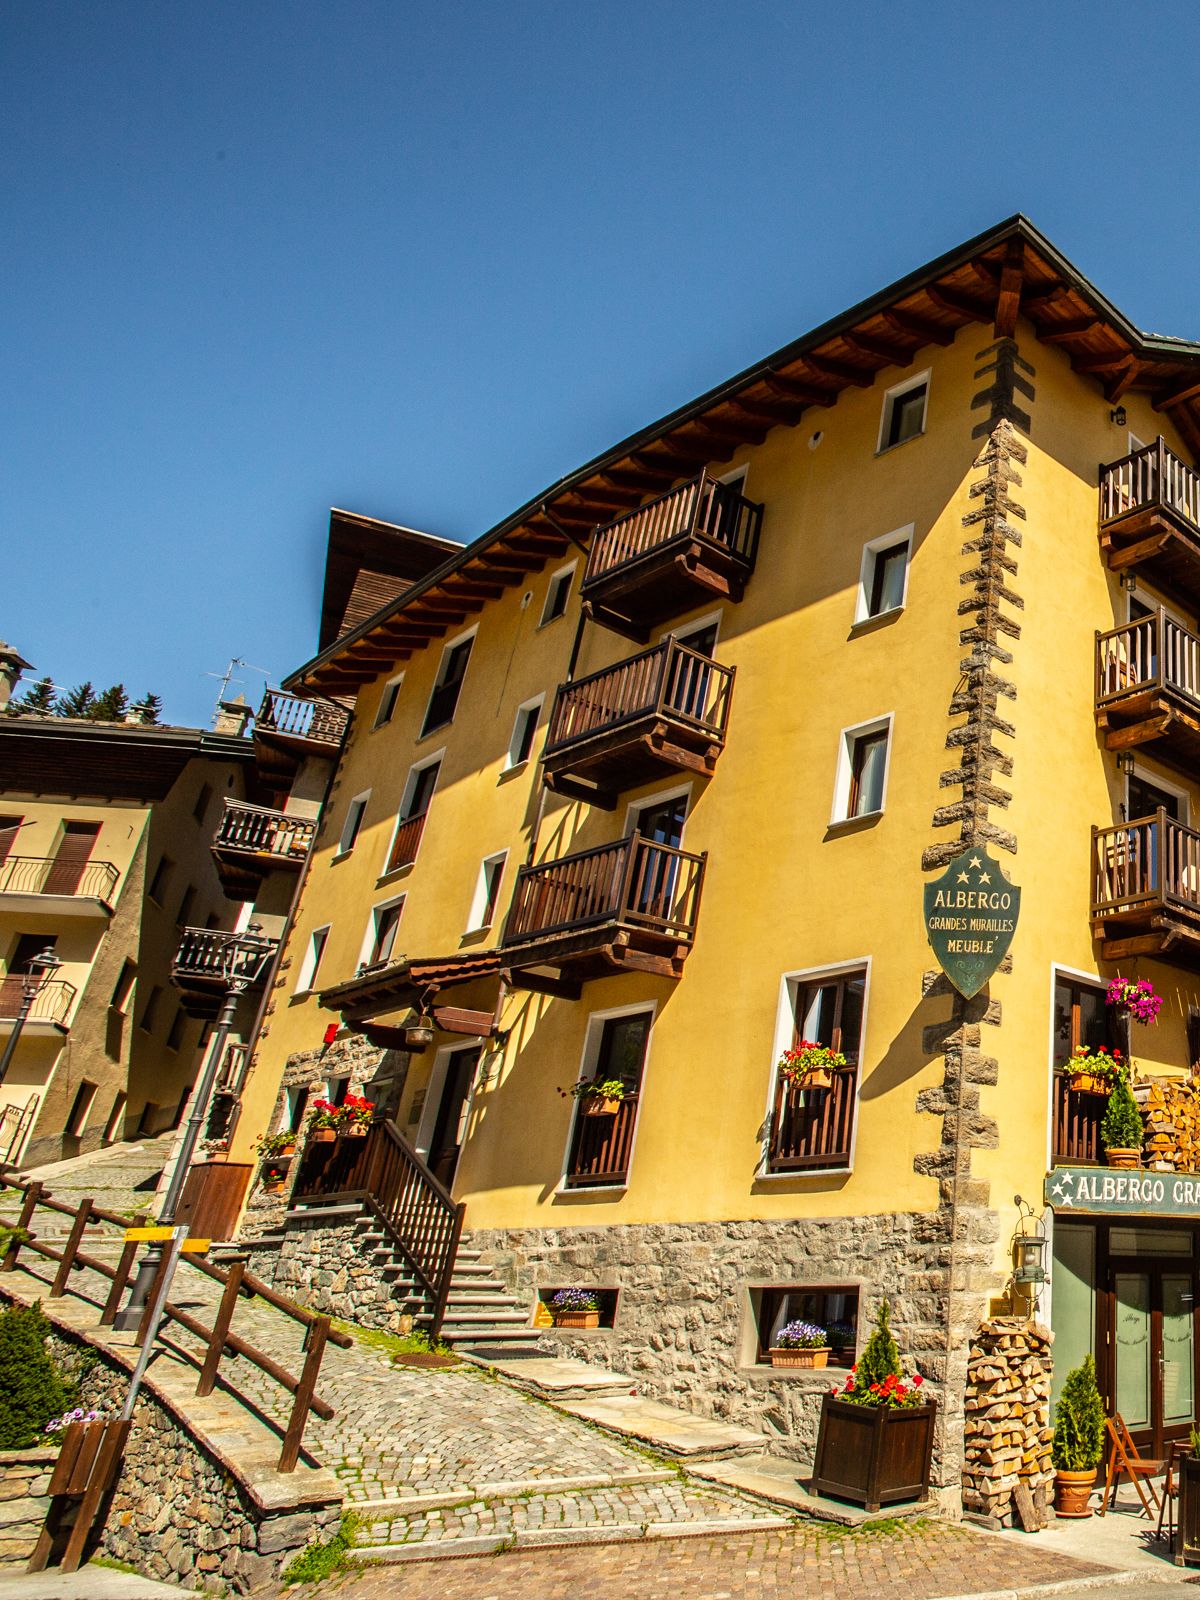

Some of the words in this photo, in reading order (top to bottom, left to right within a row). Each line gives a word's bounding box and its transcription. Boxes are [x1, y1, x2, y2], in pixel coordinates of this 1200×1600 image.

[934, 890, 1011, 909] ALBERGO
[928, 916, 967, 931] GRANDES
[969, 918, 1014, 932] MURAILLES
[1075, 1176, 1165, 1203] ALBERGO
